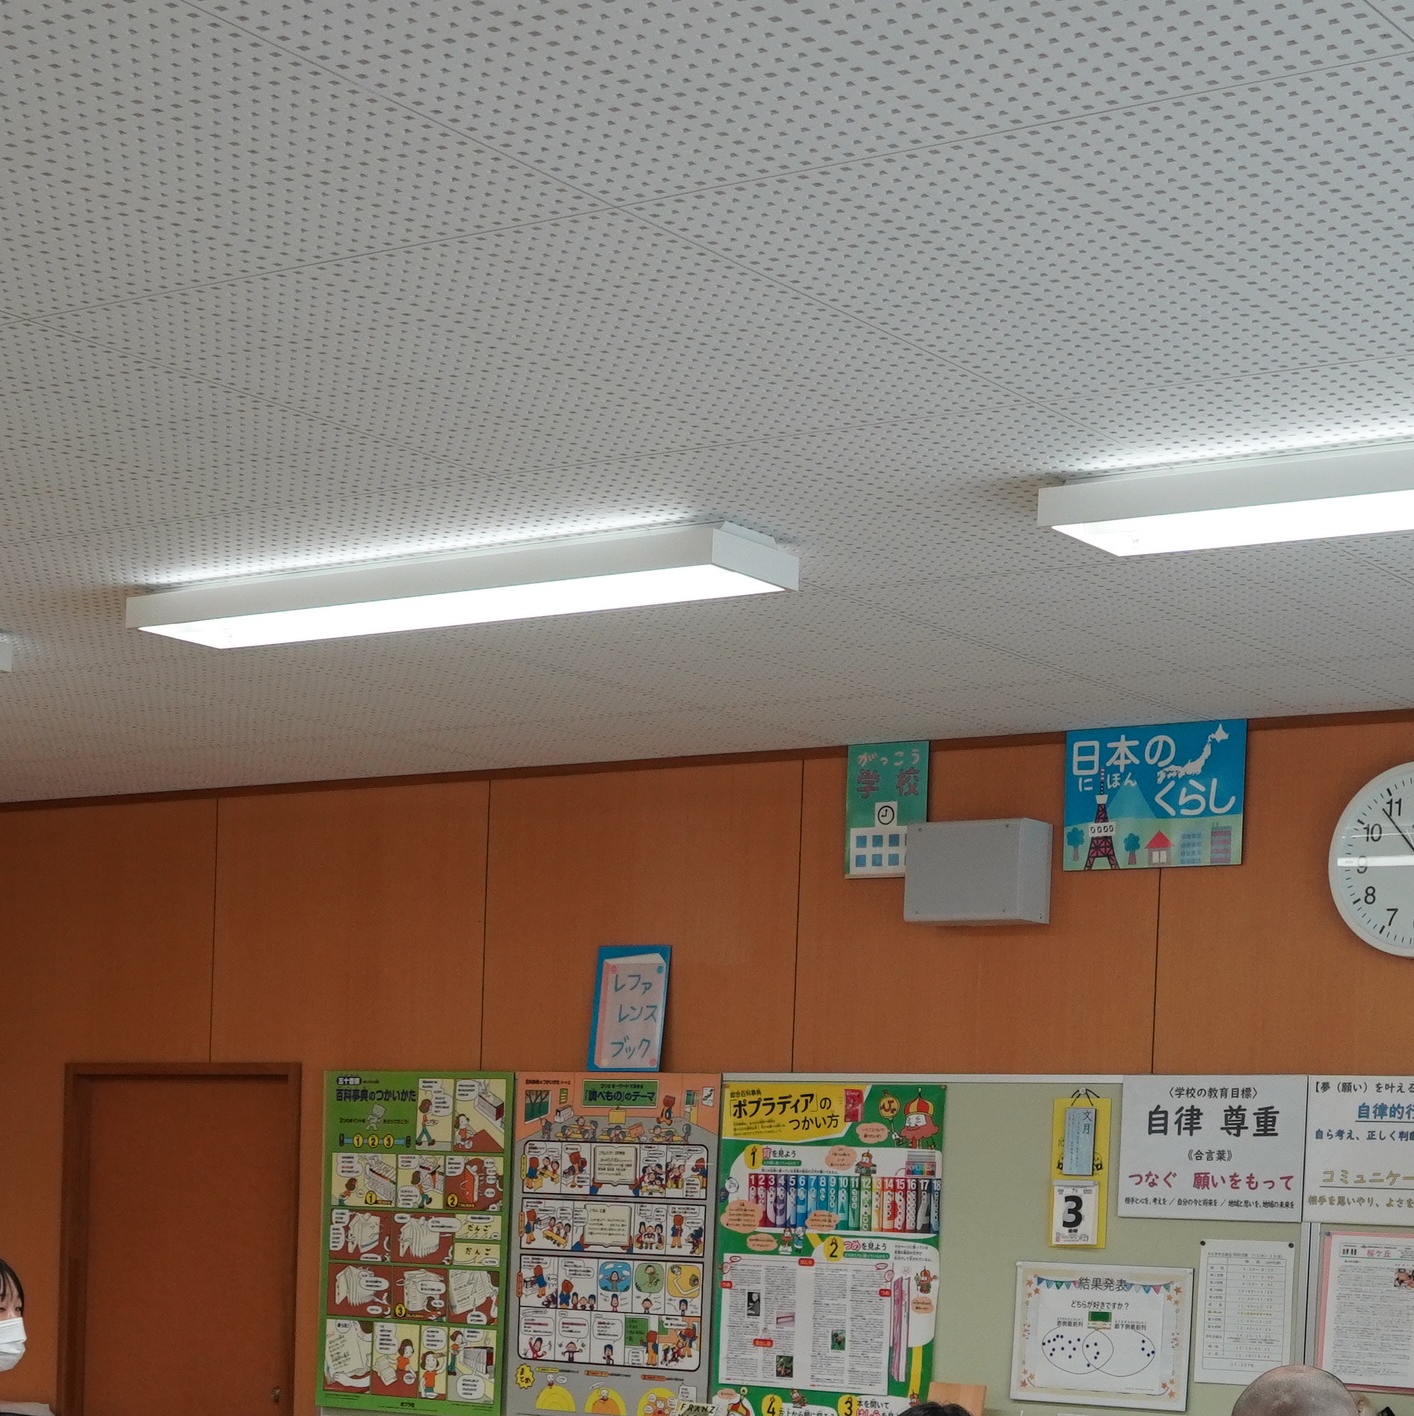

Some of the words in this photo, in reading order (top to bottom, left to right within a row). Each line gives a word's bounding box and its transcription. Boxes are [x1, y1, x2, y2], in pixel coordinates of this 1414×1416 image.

[858, 751, 920, 768] がっこう
[1073, 735, 1176, 776] 日本の
[855, 768, 920, 798] 学校
[1154, 779, 1235, 816] くらし
[1387, 799, 1401, 816] 11
[1363, 824, 1382, 842] 10
[1364, 886, 1376, 904] 8
[1387, 909, 1398, 926] 7
[614, 974, 653, 994] レファ
[618, 1004, 658, 1023] レンス
[610, 1035, 651, 1059] ブック
[1169, 1087, 1258, 1099] 〈学校の教育目標〉
[789, 1113, 840, 1131] つかい方
[1082, 1111, 1092, 1135] 文月
[1147, 1104, 1203, 1136] 自律
[1220, 1105, 1279, 1137] 尊重
[750, 1151, 756, 1167] 1
[1188, 1150, 1233, 1162] 《合言葉》
[750, 1175, 755, 1185] 1
[758, 1175, 765, 1185] 2
[768, 1175, 775, 1185] 3
[778, 1175, 785, 1185] 4
[789, 1175, 796, 1185] 5
[799, 1175, 805, 1185] 6
[810, 1175, 816, 1185] 7
[819, 1175, 826, 1186] 8
[830, 1175, 836, 1186] 9
[839, 1176, 848, 1186] 10
[851, 1176, 859, 1186] 11
[862, 1179, 871, 1189] 12
[884, 1179, 894, 1189] 14
[896, 1179, 905, 1190] 15
[907, 1179, 916, 1190] 16
[919, 1180, 929, 1190] 17
[1129, 1170, 1177, 1188] つなぐ
[1193, 1172, 1294, 1191] 願いをもって
[1062, 1195, 1083, 1228] 3
[829, 1242, 838, 1257] 2
[844, 1241, 887, 1251] つめを見よう
[1078, 1277, 1127, 1292] 結果発表
[1070, 1300, 1130, 1310] どちらが好きですか？
[681, 1404, 716, 1413] FRANZ
[767, 1402, 776, 1416] 4
[844, 1401, 853, 1416] 3
[857, 1401, 890, 1409] 本を開いて
